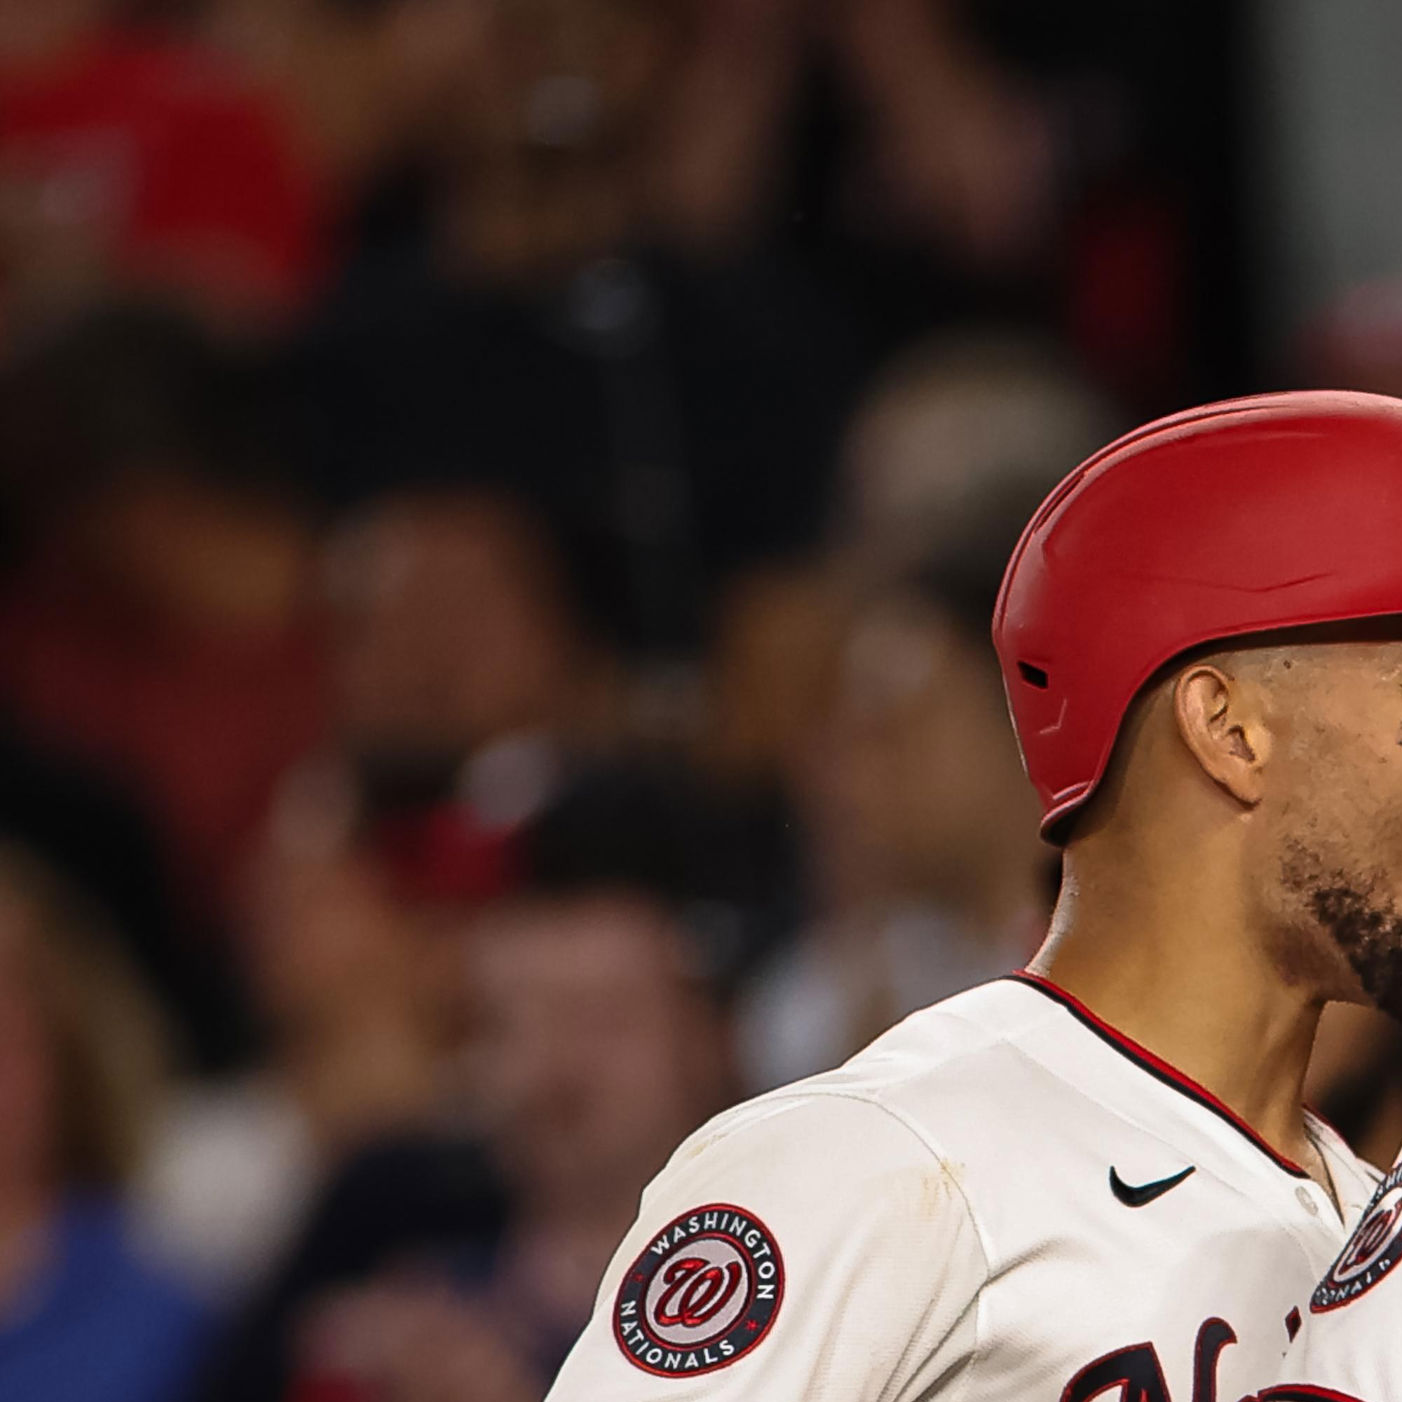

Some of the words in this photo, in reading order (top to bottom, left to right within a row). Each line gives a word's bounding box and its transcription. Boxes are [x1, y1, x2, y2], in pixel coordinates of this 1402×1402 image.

[651, 1212, 775, 1299] WASHINGTON
[654, 1257, 742, 1327] W
[620, 1300, 735, 1369] NATIONALS
